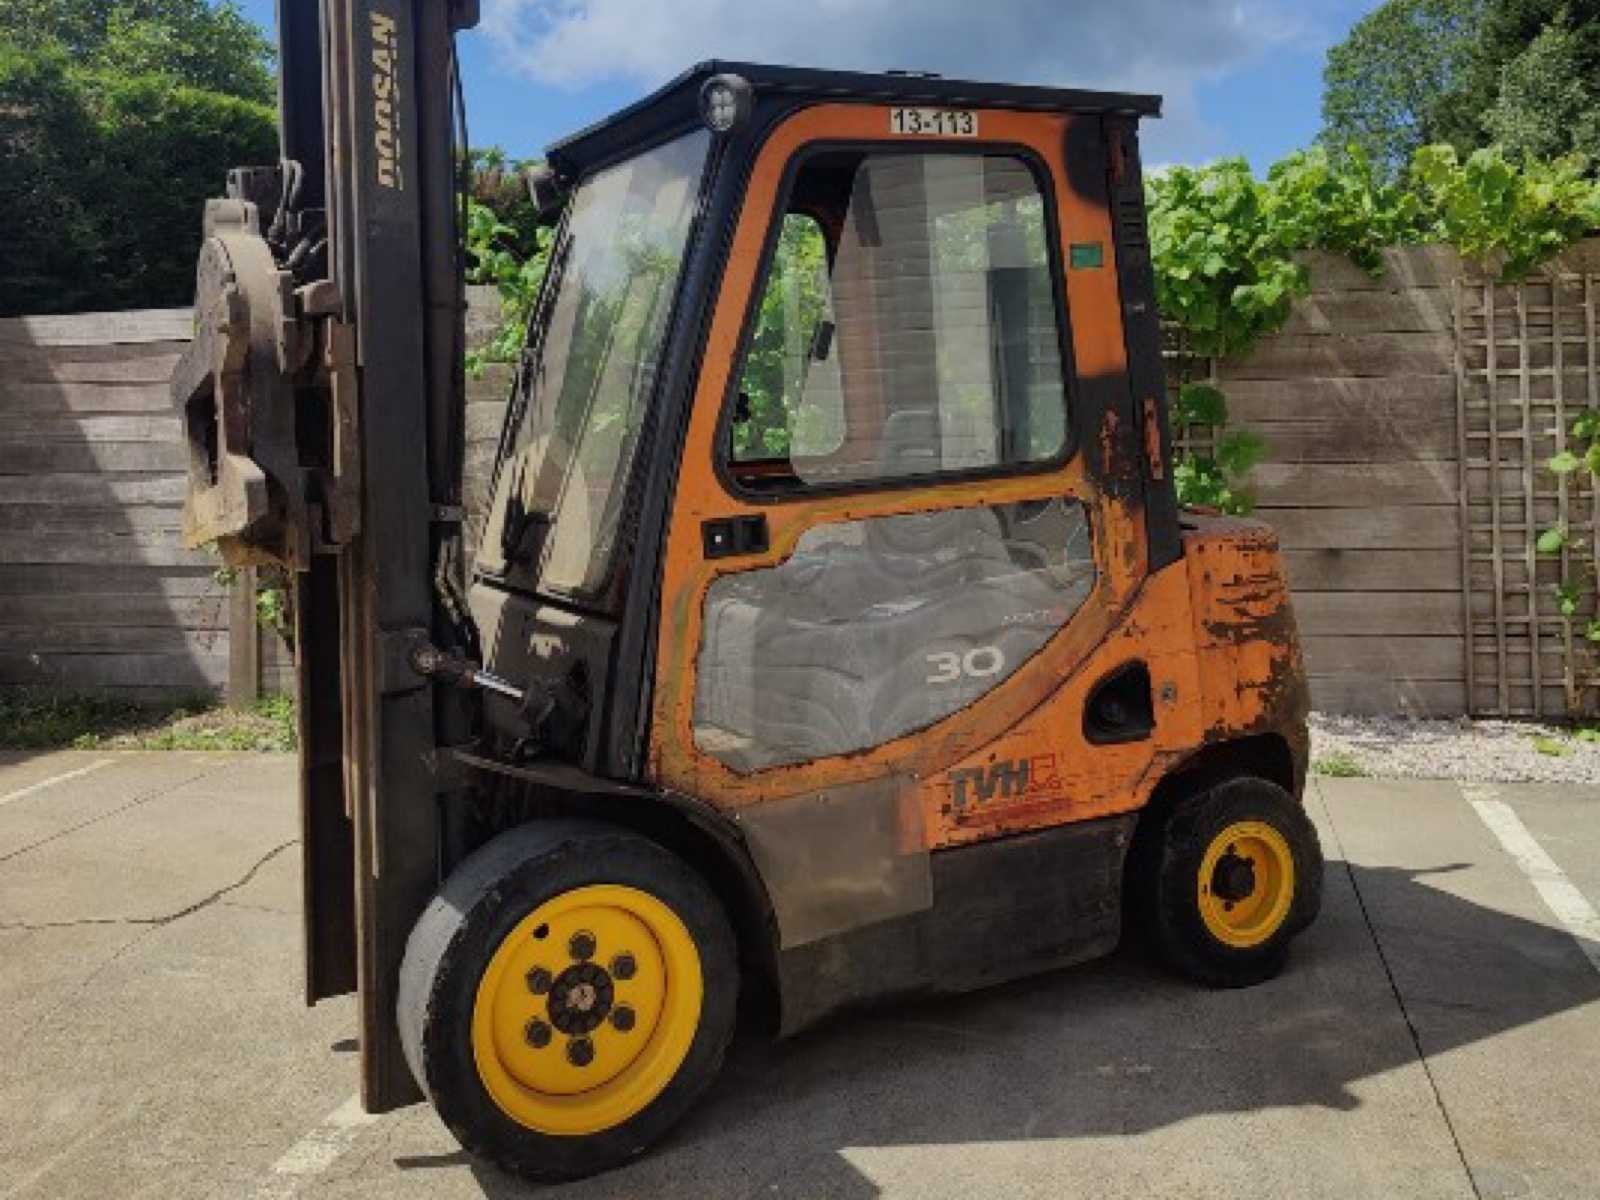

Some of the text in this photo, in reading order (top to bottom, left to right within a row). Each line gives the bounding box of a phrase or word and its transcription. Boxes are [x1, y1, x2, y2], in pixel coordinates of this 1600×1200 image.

[893, 109, 973, 135] 13-113
[926, 646, 1005, 684] 30
[950, 758, 1029, 806] TVH
